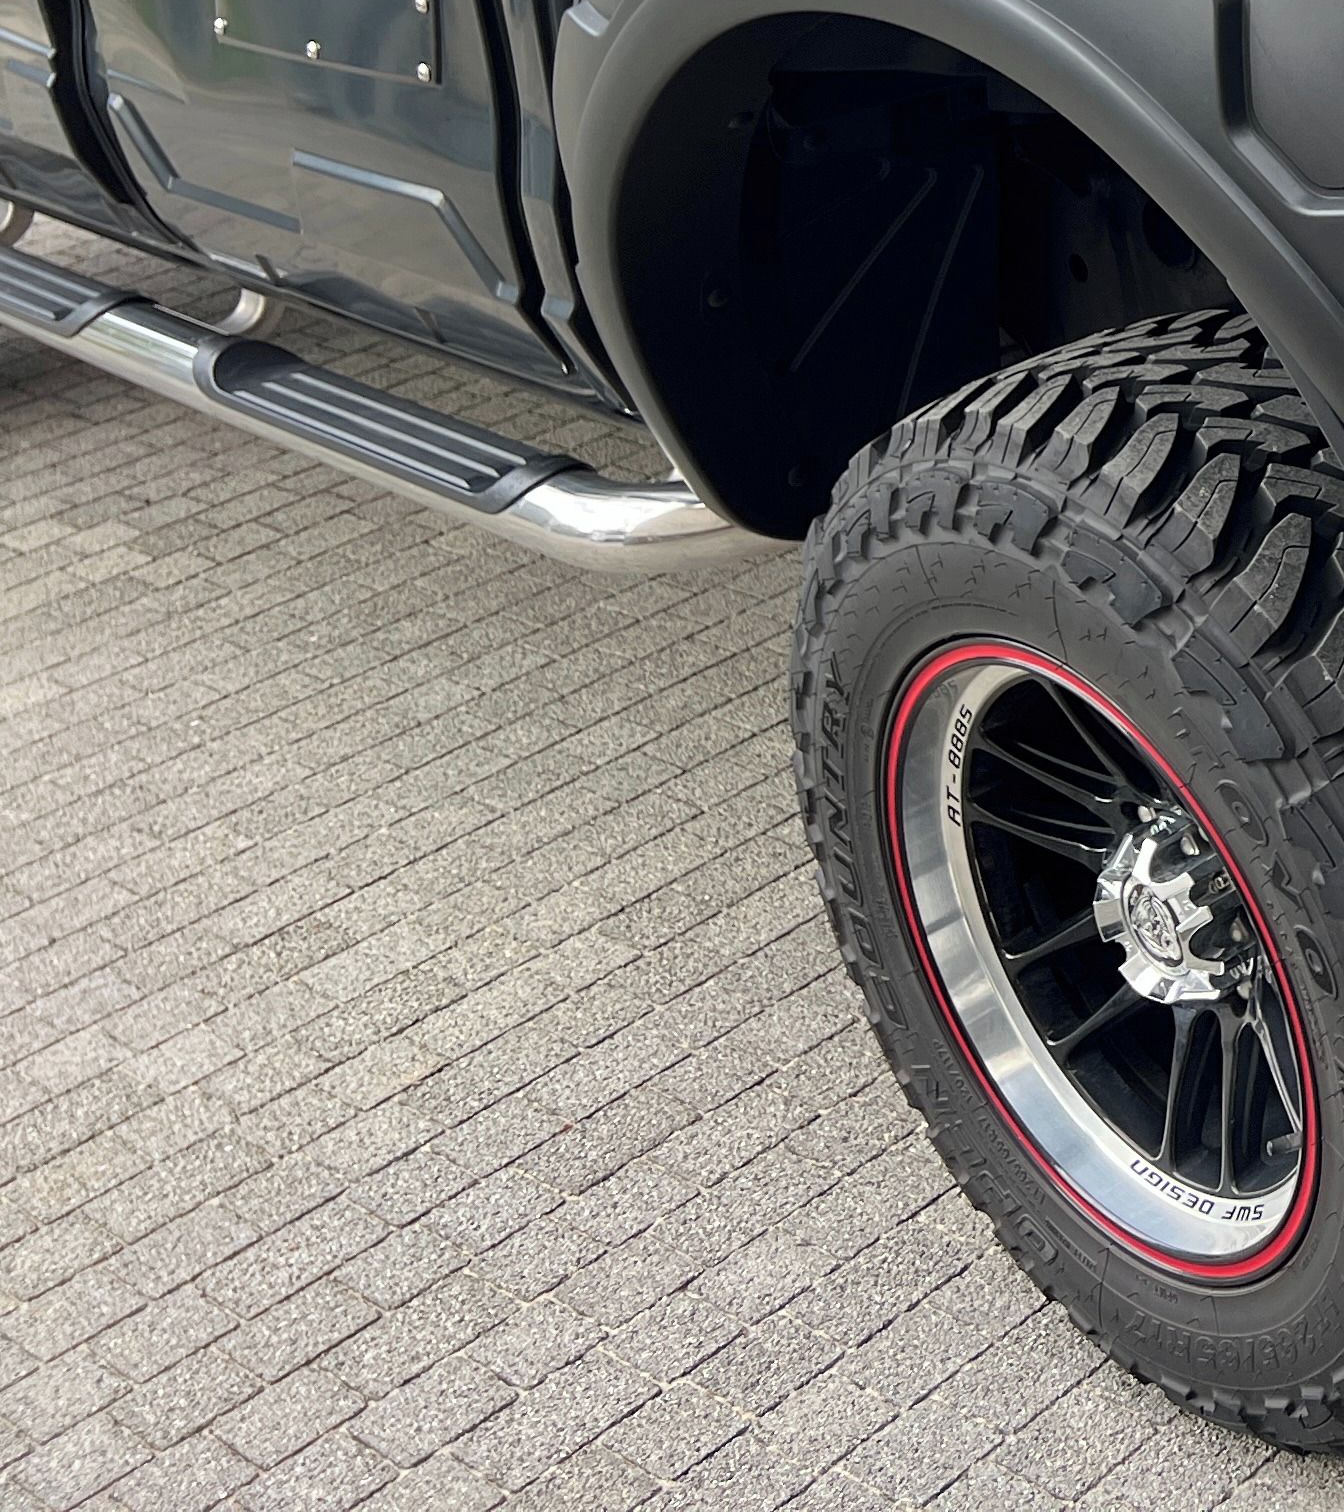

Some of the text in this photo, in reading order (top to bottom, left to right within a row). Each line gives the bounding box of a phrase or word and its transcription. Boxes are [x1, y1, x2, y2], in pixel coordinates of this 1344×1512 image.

[820, 650, 911, 1034] COUNTRY
[1168, 705, 1340, 999] TOYO
[1129, 1159, 1265, 1221] SWF DESIGN
